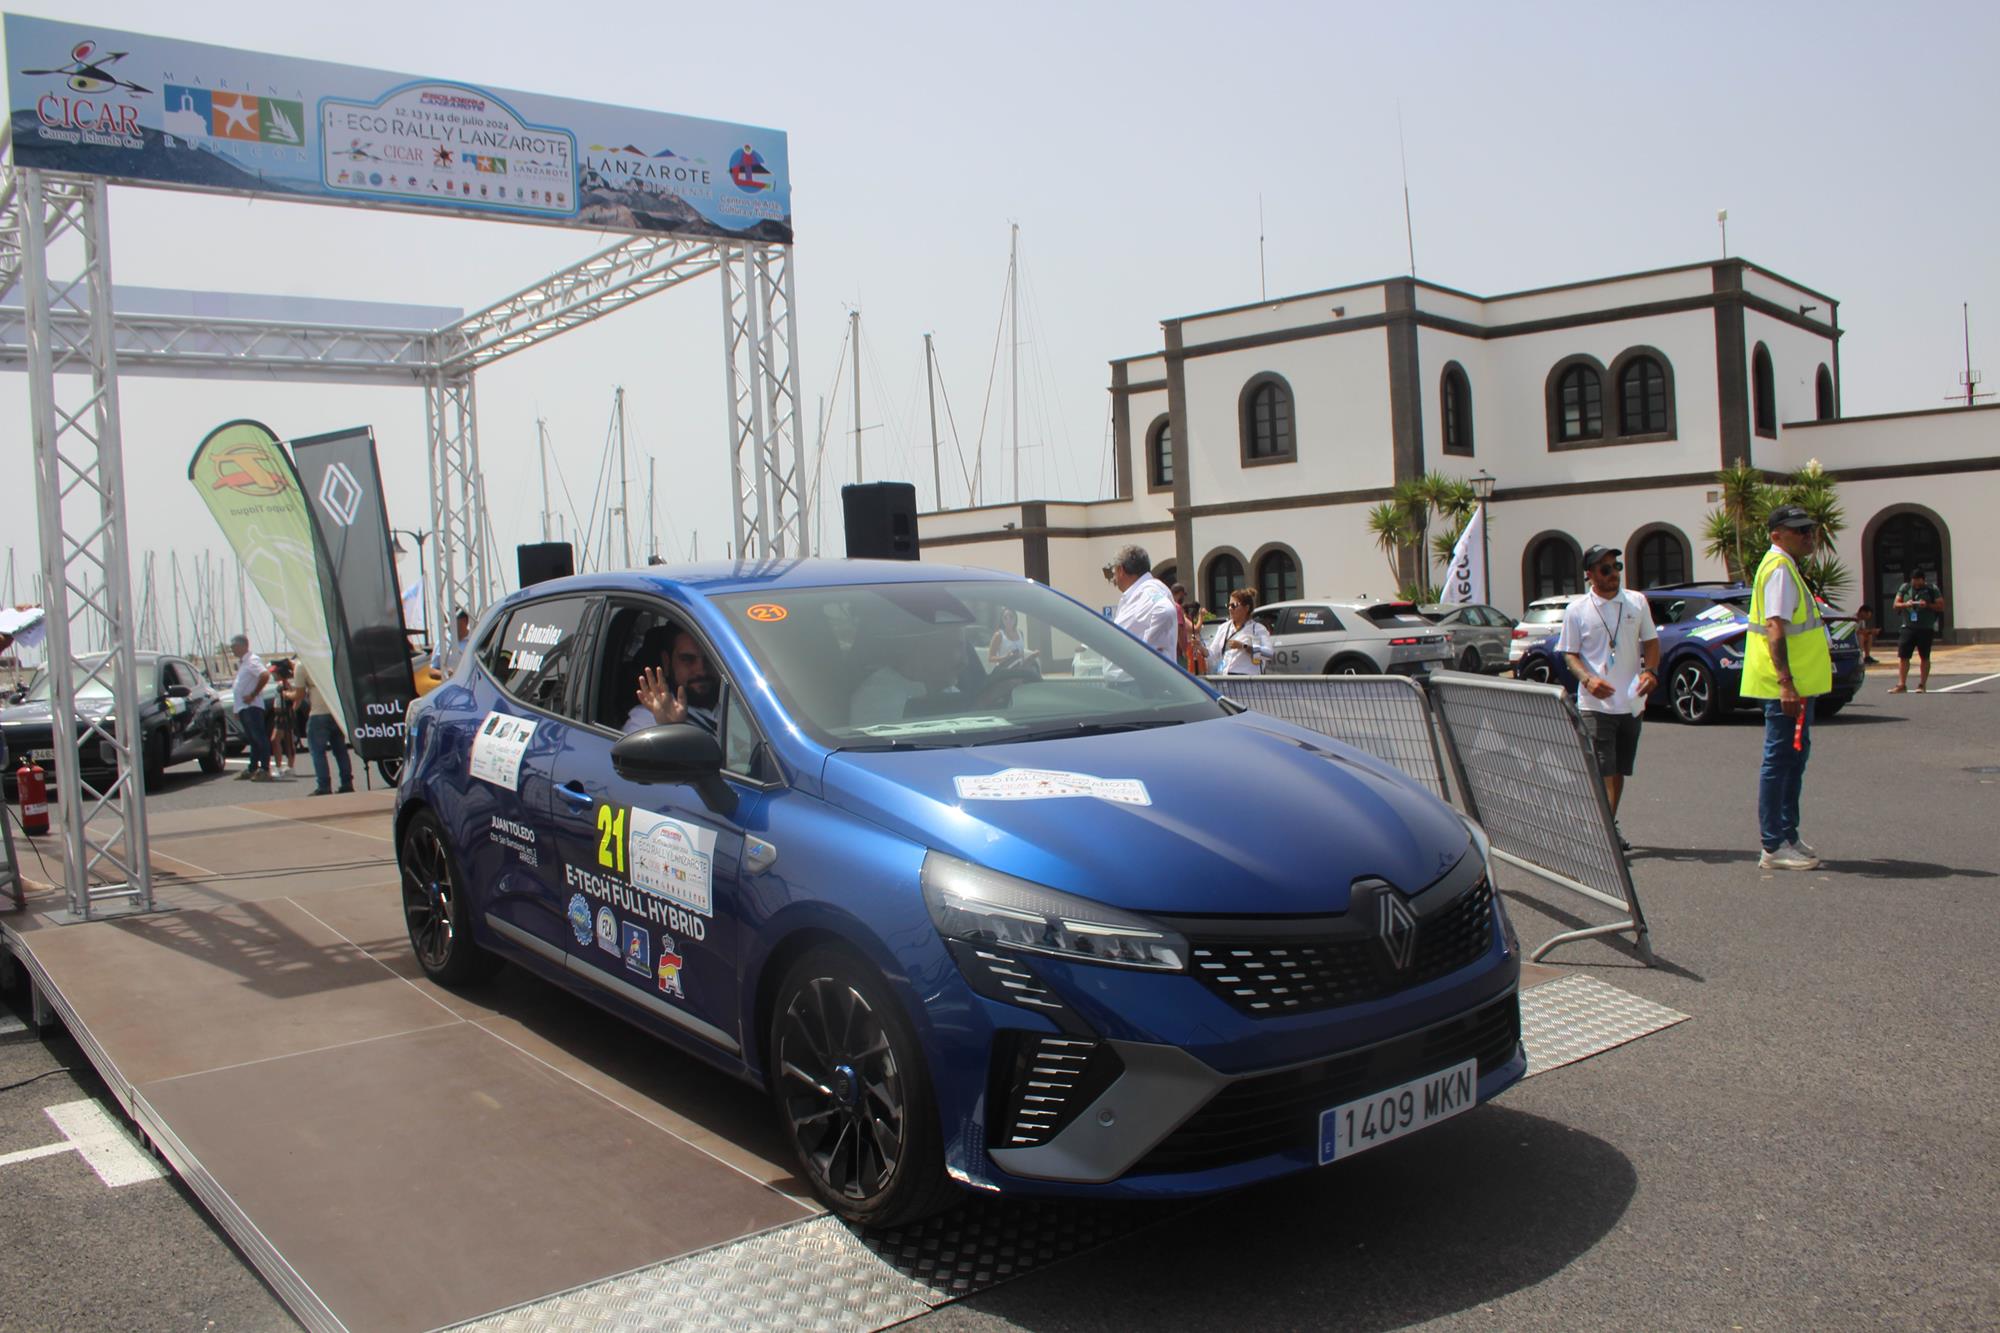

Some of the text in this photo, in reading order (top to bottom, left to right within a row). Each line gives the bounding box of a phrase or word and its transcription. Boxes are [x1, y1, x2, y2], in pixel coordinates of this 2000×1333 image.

[163, 71, 304, 98] MARINA
[37, 95, 143, 136] CICAR
[412, 109, 423, 120] 13
[434, 112, 445, 122] 14
[447, 112, 461, 123] de
[462, 113, 484, 127] julio
[486, 119, 509, 131] 2024
[39, 127, 144, 149] Canary Islands Car
[347, 112, 388, 134] ECO
[392, 119, 455, 142] RALLY
[458, 127, 568, 158] LANZAROTE
[383, 143, 424, 161] CICAR
[513, 164, 569, 178] LANZAROTE
[586, 156, 711, 184] LANZAROTE
[1291, 650, 1300, 664] 5
[492, 815, 535, 843] JUAN TOLEDO
[597, 804, 625, 873] 21
[565, 863, 705, 942] E-TECH FULL HYBRID
[1346, 1067, 1471, 1148] 1409 MKN
[1325, 1142, 1331, 1153] E
